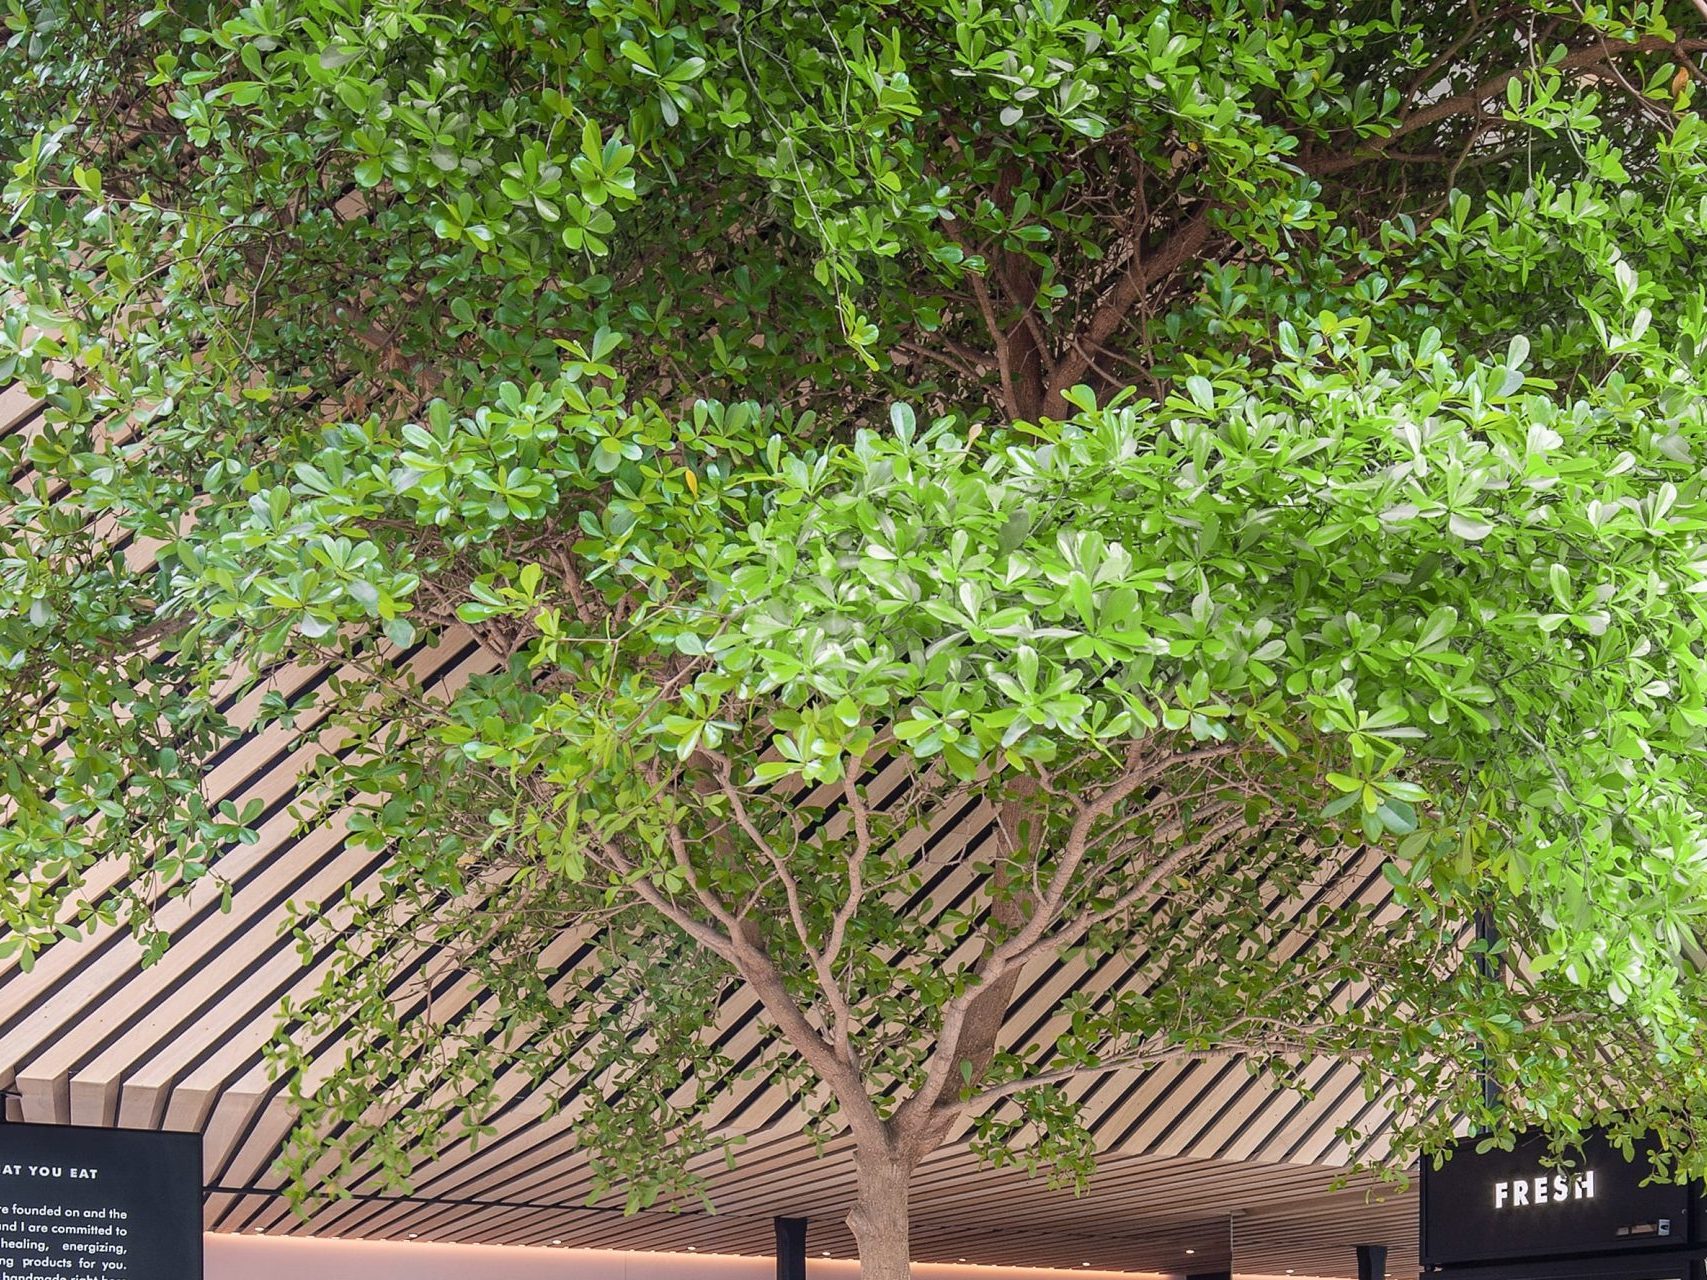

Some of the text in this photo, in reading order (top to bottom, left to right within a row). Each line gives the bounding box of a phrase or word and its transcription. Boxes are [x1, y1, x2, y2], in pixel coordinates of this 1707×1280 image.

[29, 1166, 61, 1177] YOU
[71, 1168, 97, 1179] EAT
[1495, 1170, 1595, 1209] FRESH
[12, 1204, 61, 1216] founded
[83, 1208, 105, 1218] and
[109, 1209, 127, 1219] the
[21, 1222, 24, 1231] I
[52, 1225, 112, 1235] committed
[116, 1227, 127, 1236] to
[1, 1238, 127, 1255] healing, energizing,
[23, 1256, 72, 1268] products
[79, 1258, 96, 1268] for
[102, 1262, 126, 1271] you.
